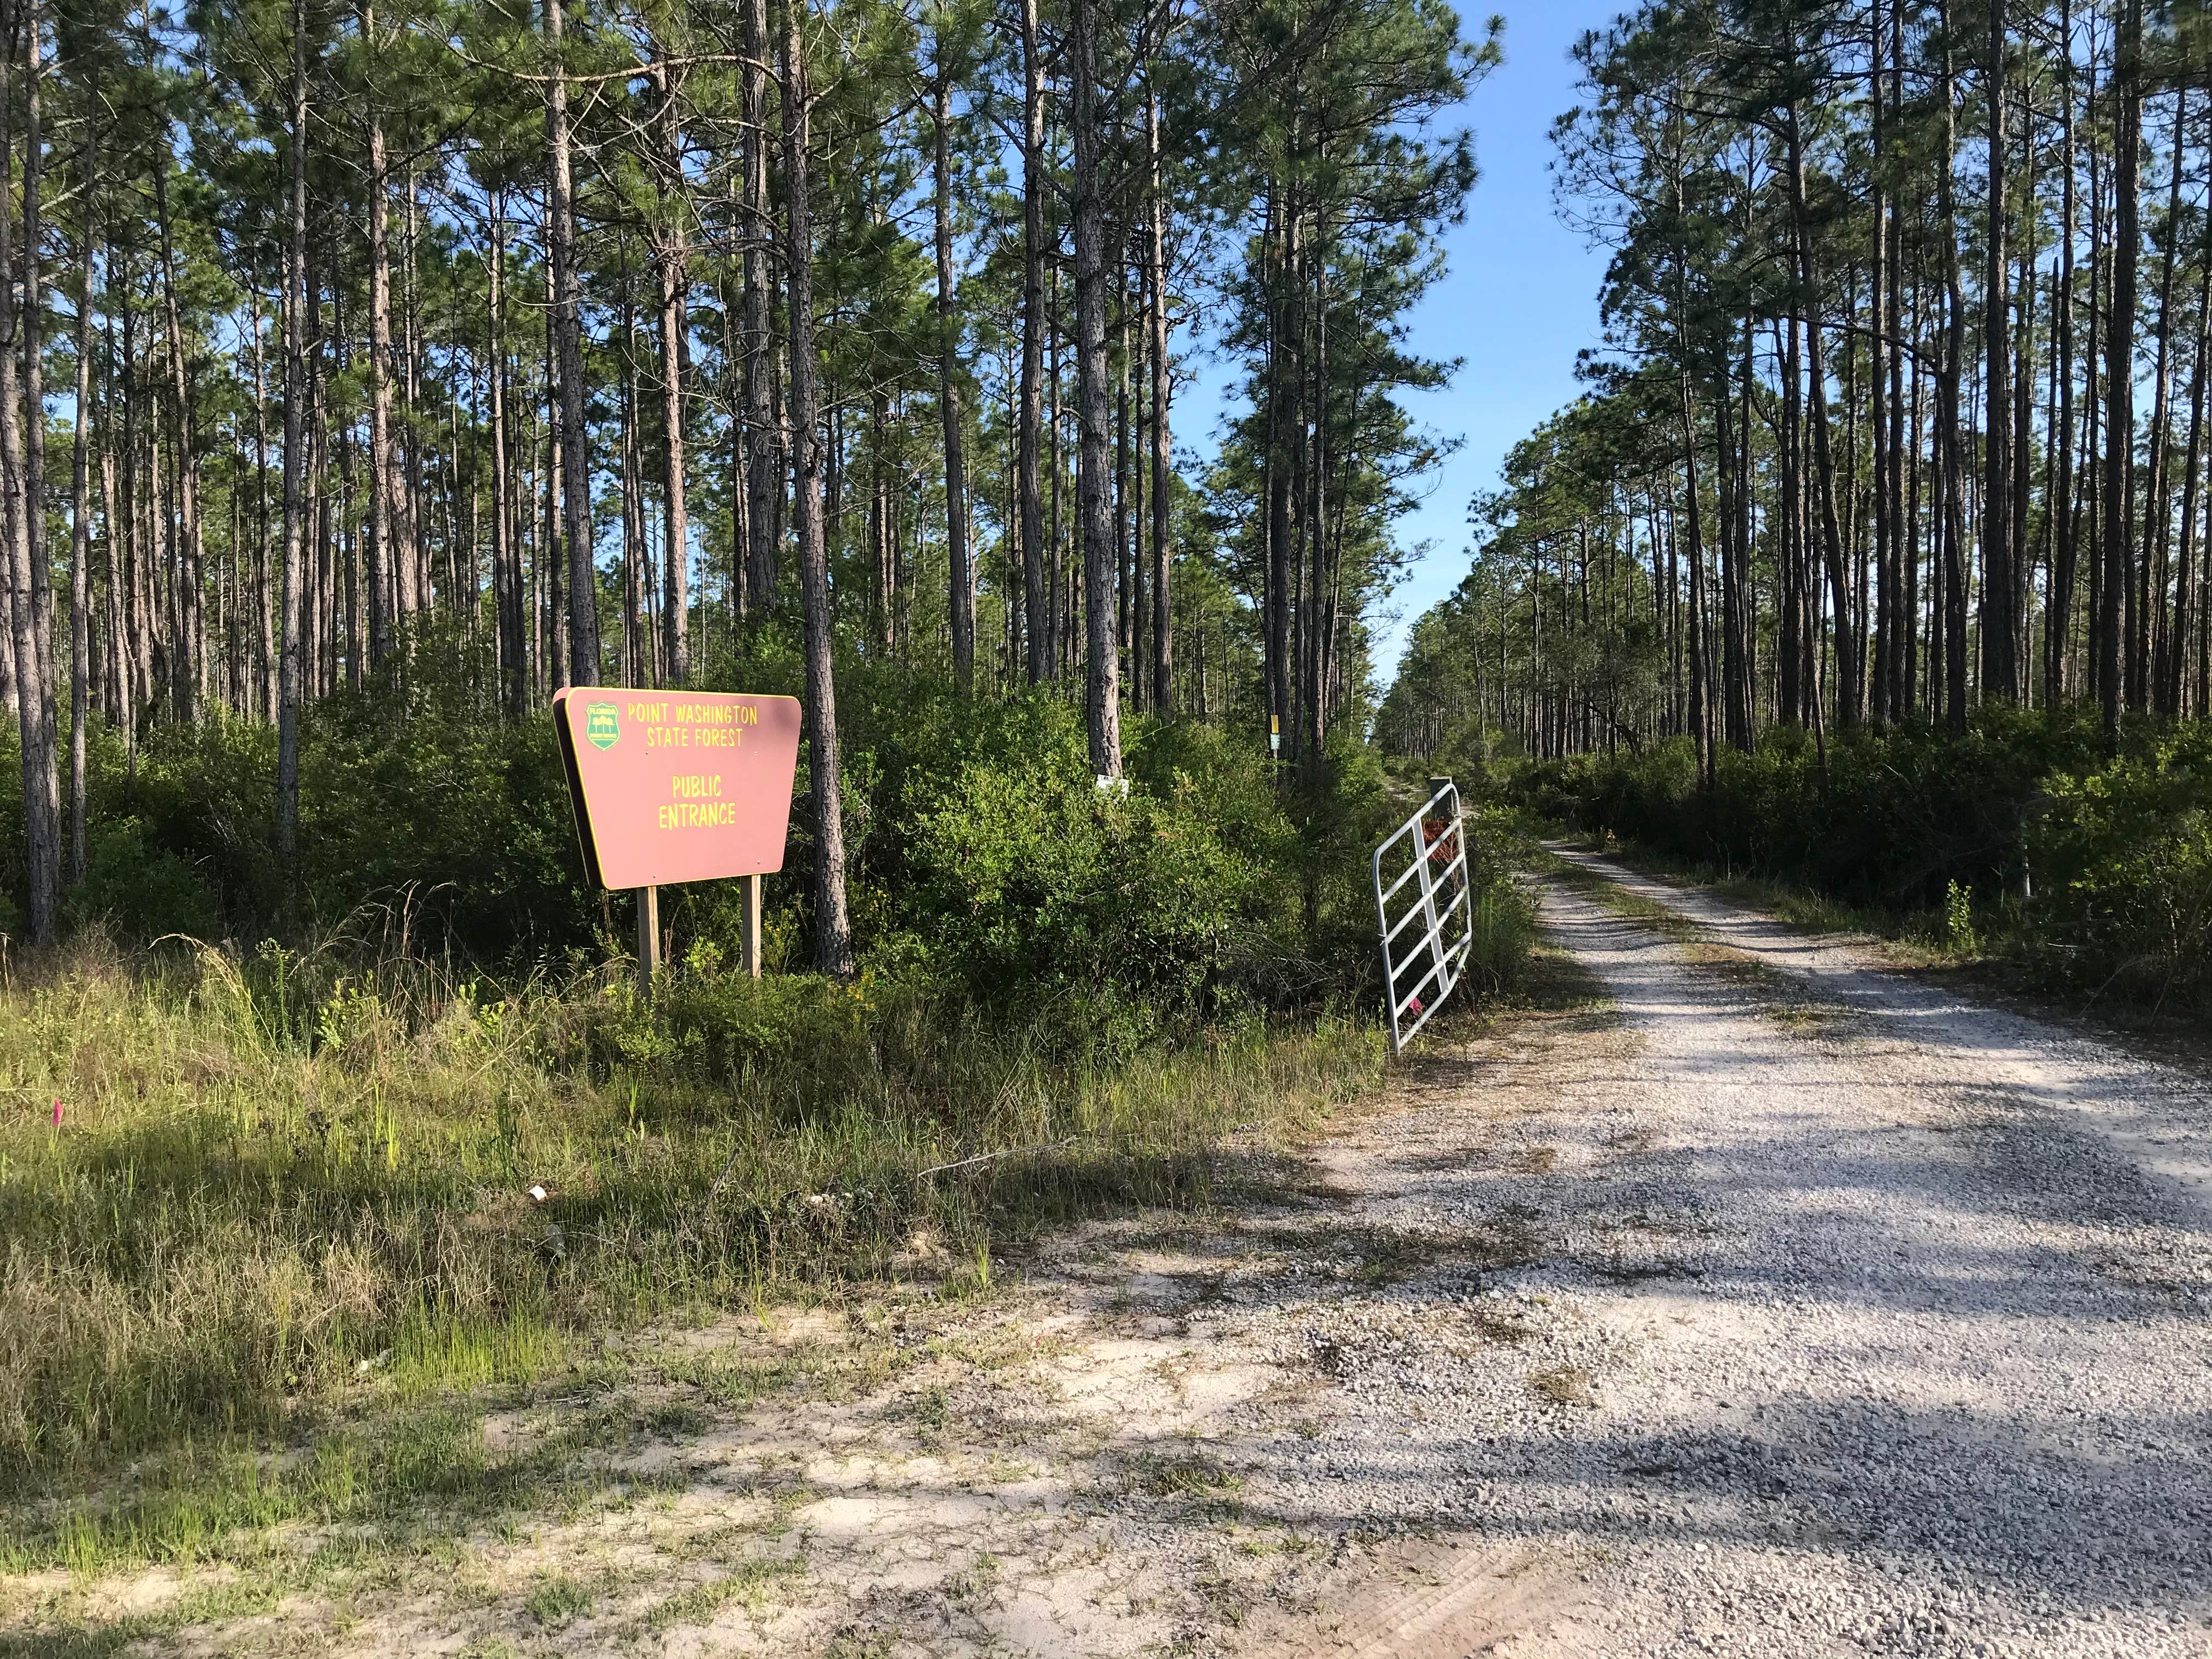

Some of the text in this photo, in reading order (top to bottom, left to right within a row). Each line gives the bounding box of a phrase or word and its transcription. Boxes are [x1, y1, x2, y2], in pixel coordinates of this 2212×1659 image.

[627, 702, 758, 725] POINT WASHINGTON
[647, 727, 743, 747] STATE FOREST
[672, 774, 722, 798] PUBLIC
[658, 801, 736, 830] ENTRANCE
